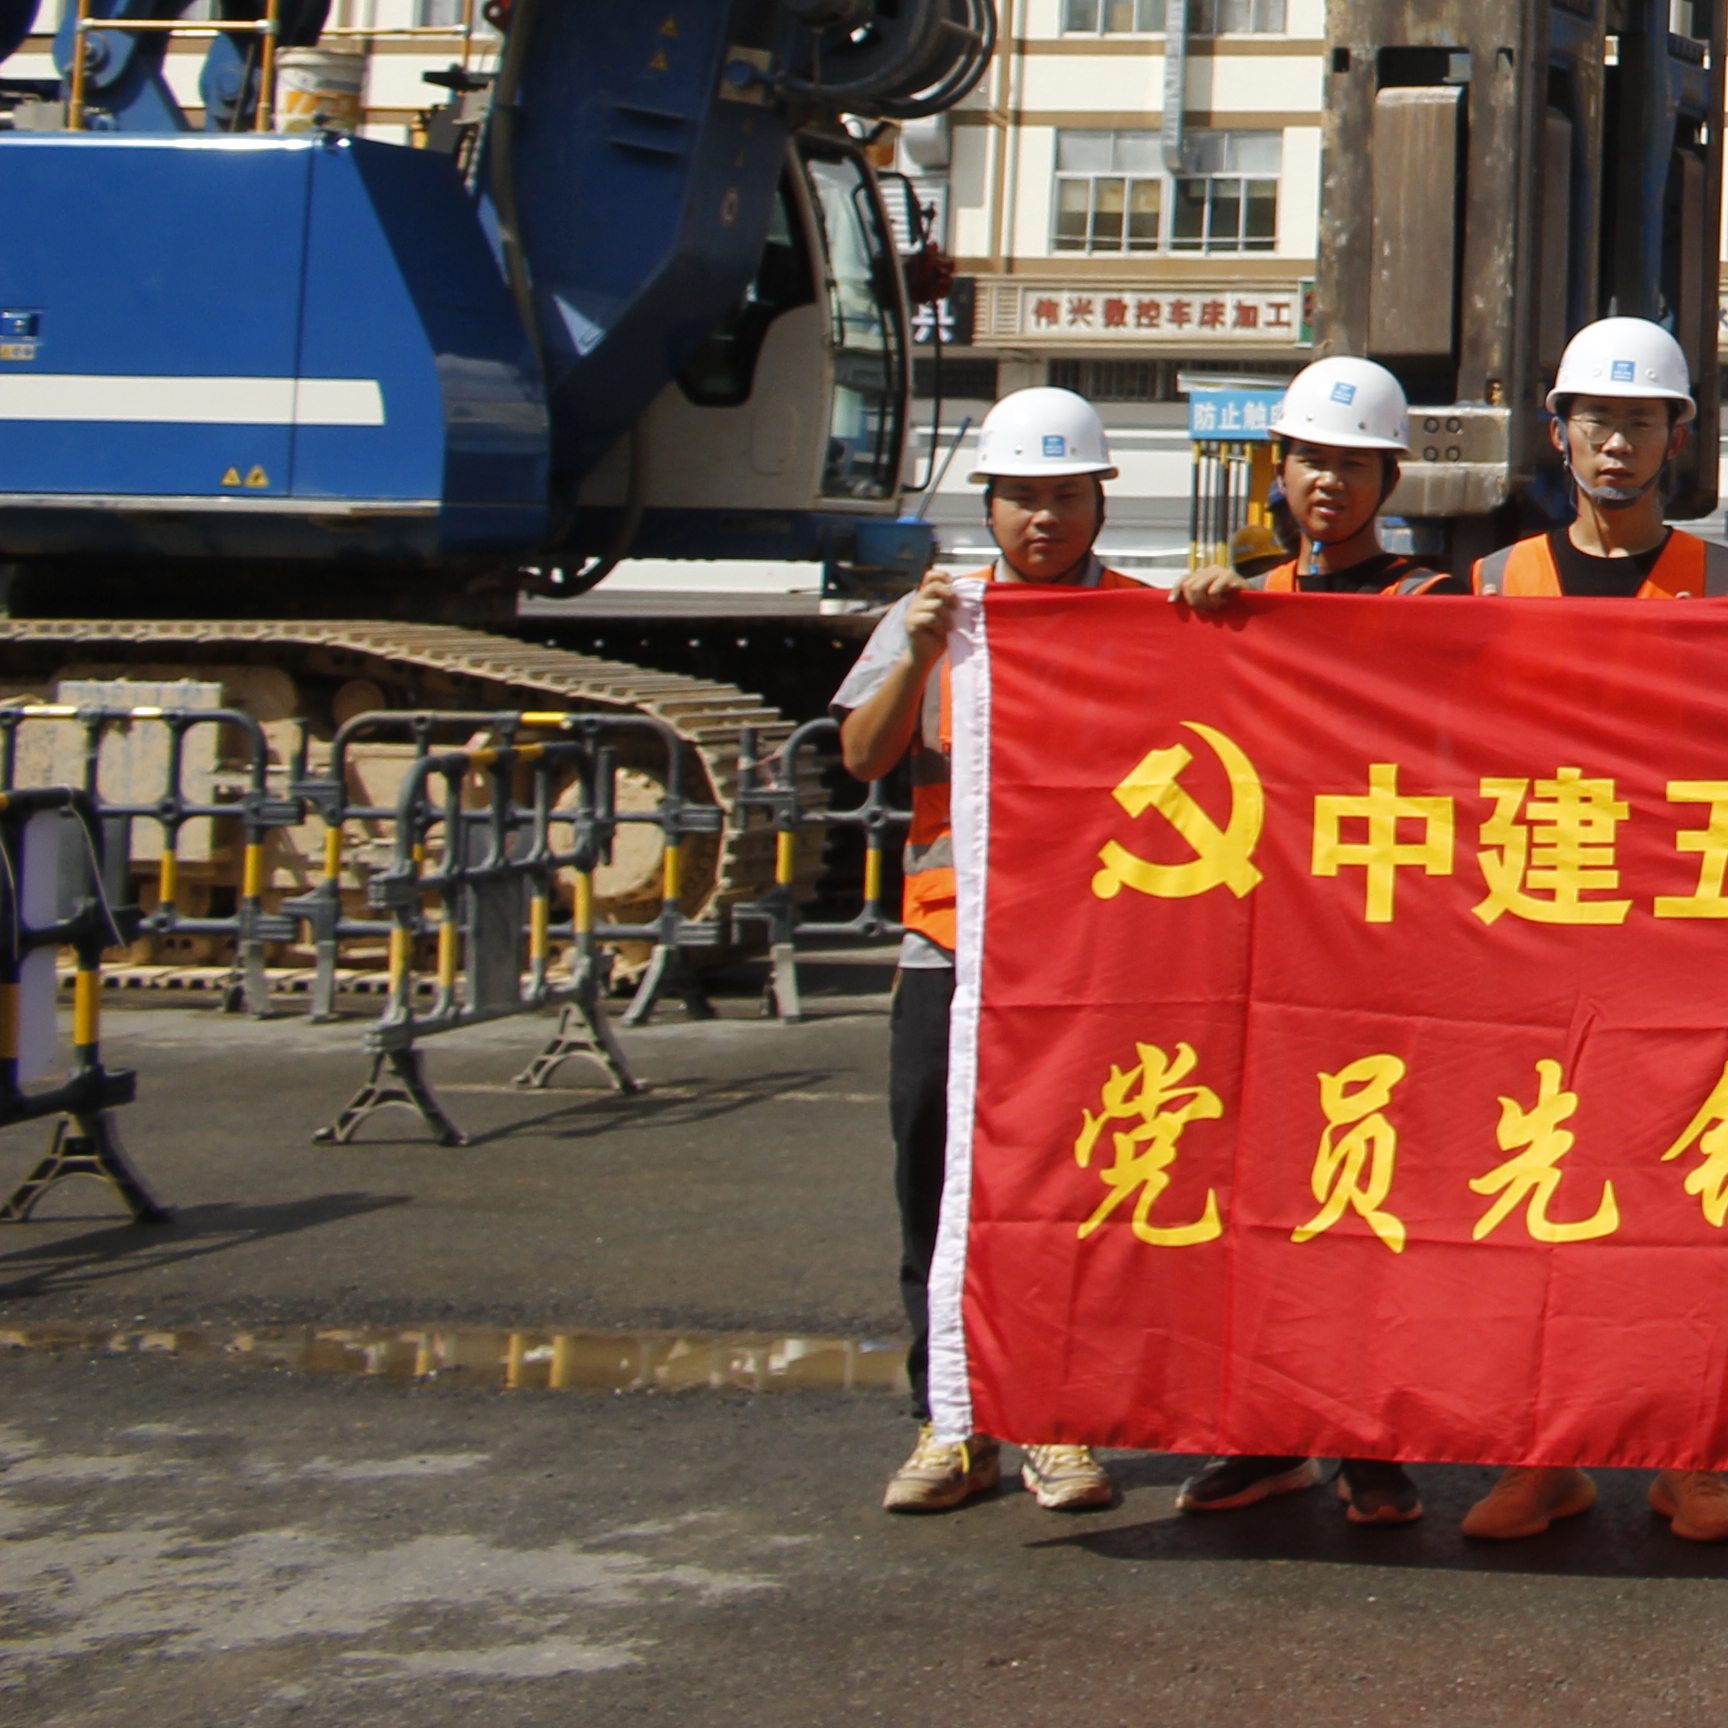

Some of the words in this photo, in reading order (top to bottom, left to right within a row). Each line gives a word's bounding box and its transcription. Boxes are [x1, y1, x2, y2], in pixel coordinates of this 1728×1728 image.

[1032, 297, 1291, 329] 伟兴数控车床加工
